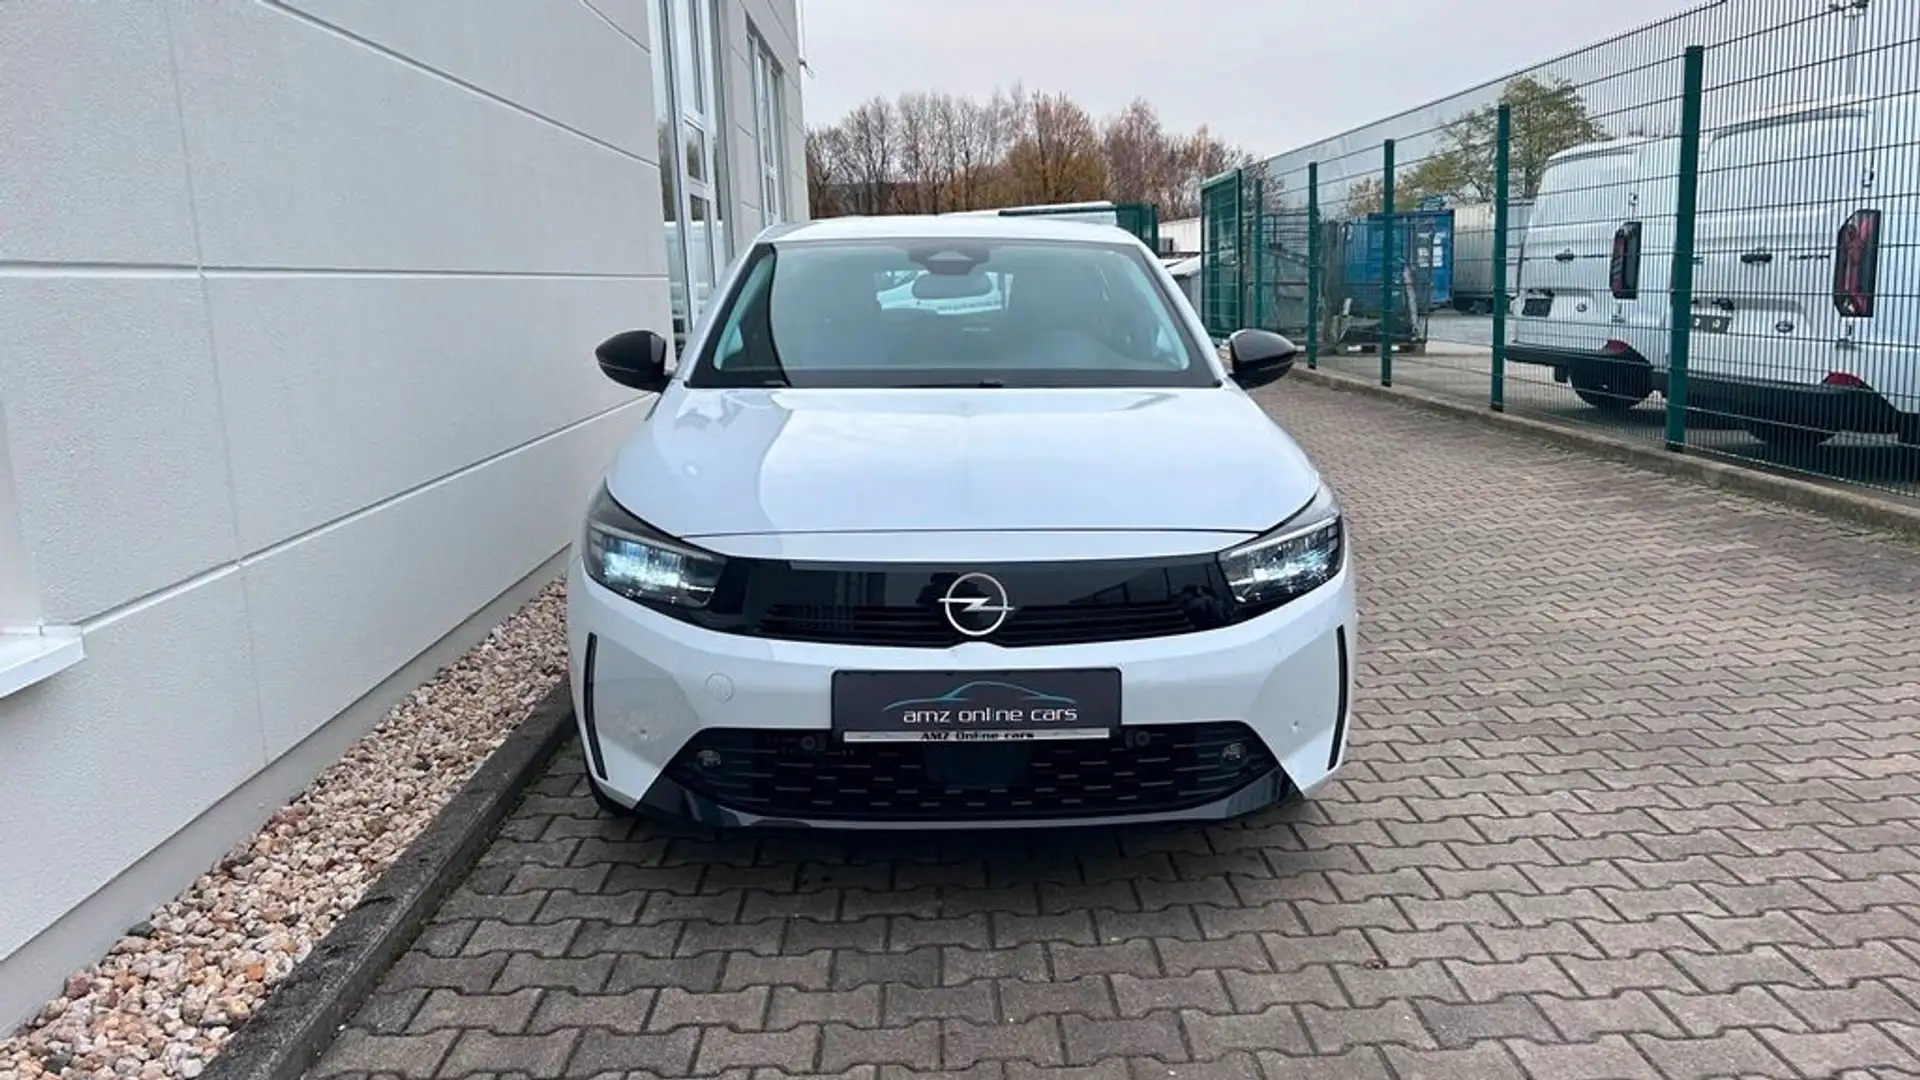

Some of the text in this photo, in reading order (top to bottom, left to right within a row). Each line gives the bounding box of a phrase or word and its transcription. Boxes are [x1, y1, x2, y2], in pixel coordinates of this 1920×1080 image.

[903, 707, 1078, 723] amz online cars
[920, 732, 949, 741] AMZ
